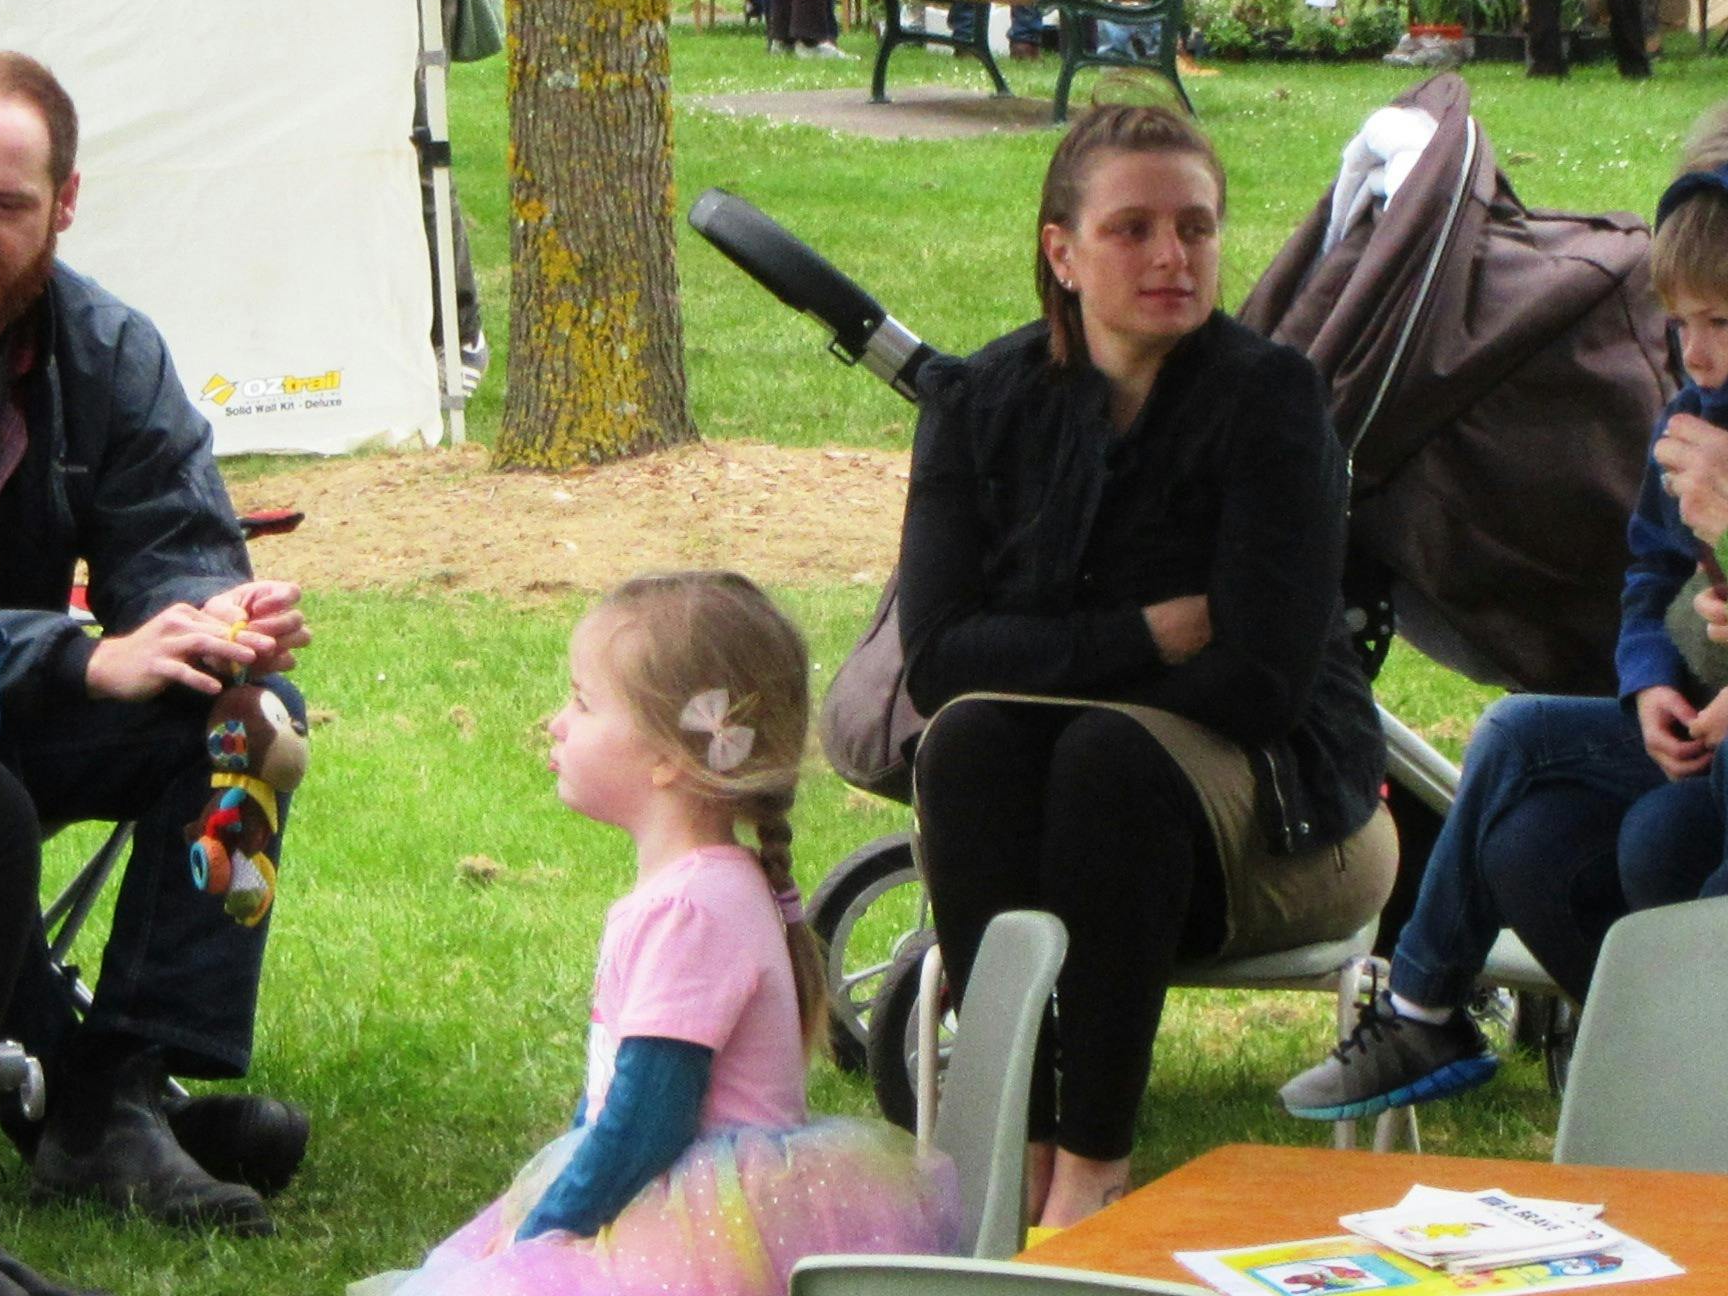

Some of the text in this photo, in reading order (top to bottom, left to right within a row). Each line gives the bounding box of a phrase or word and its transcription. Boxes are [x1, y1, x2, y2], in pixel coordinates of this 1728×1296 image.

[242, 370, 342, 399] OZtrail
[224, 405, 253, 417] Solid
[255, 403, 278, 414] Wall
[280, 401, 295, 412] Kit
[304, 398, 343, 410] Deluxe
